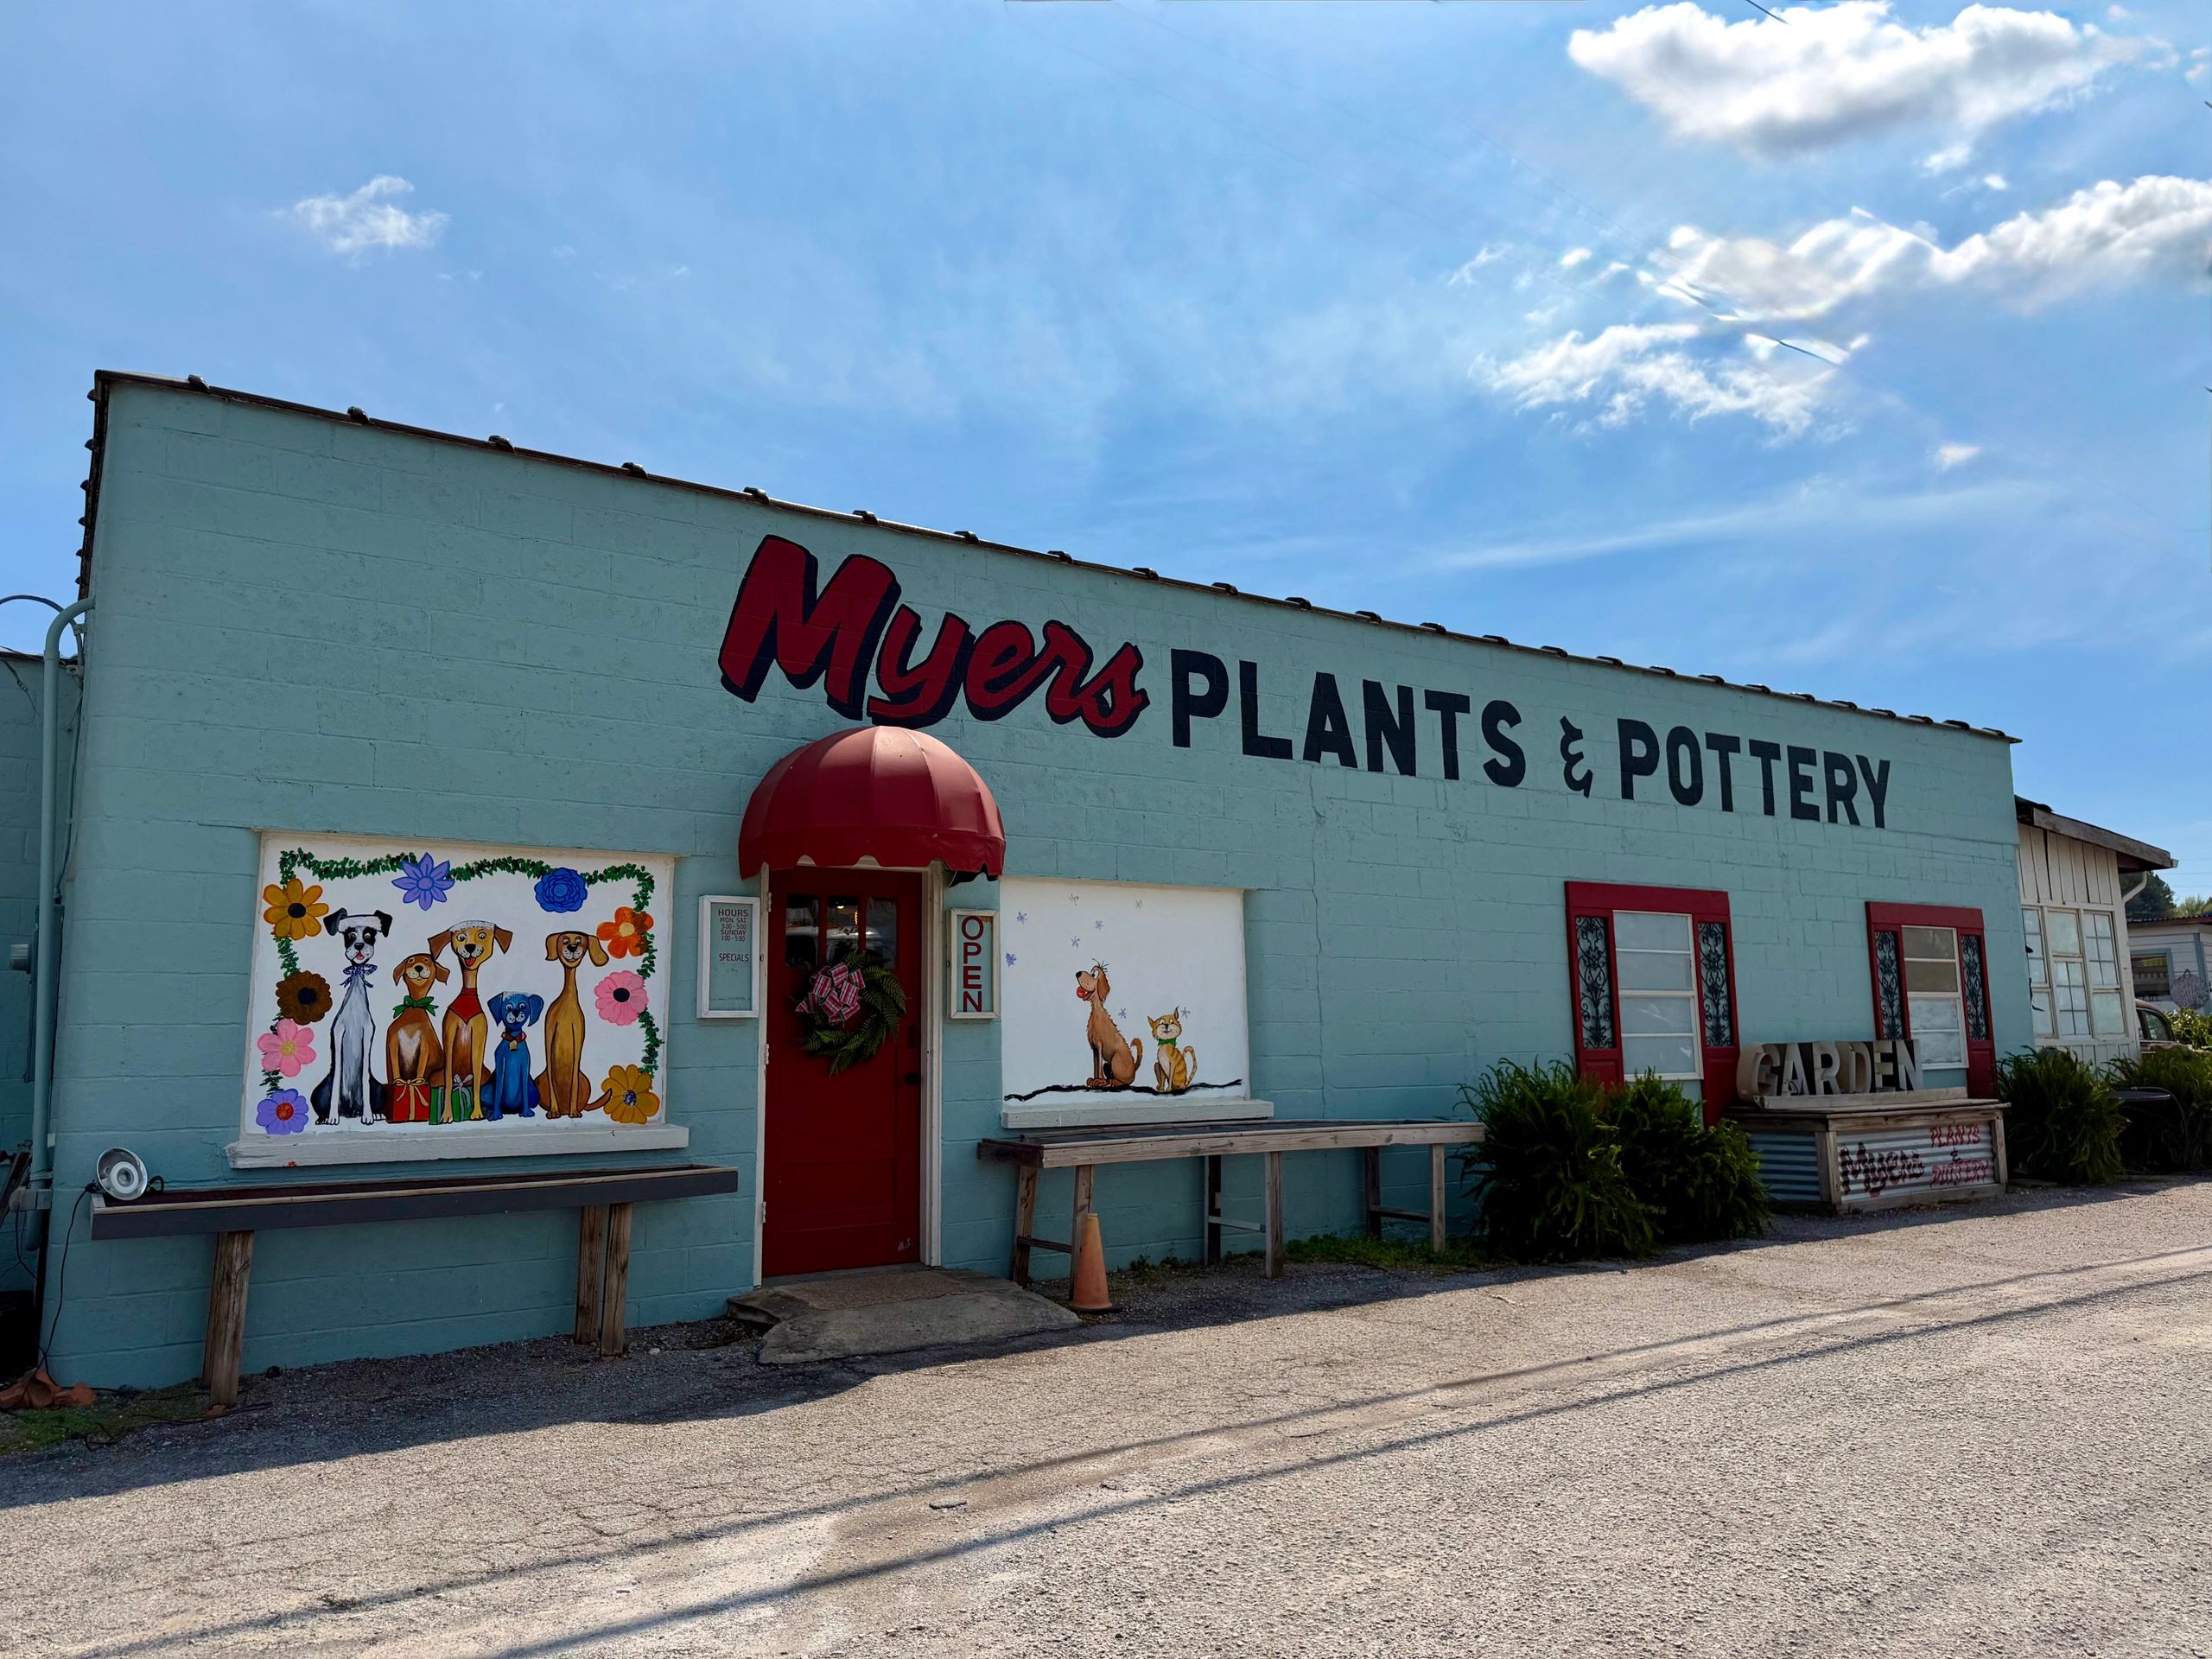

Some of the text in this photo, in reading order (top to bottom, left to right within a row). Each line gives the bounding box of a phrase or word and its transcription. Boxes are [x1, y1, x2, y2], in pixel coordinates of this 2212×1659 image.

[718, 534, 1891, 830] Myers PLANTS & POTTERY
[719, 953, 749, 962] SPECIALS
[961, 915, 984, 1012] OPEN
[1737, 1039, 1920, 1100] GARDEN
[1929, 1124, 1981, 1147] PLANTS
